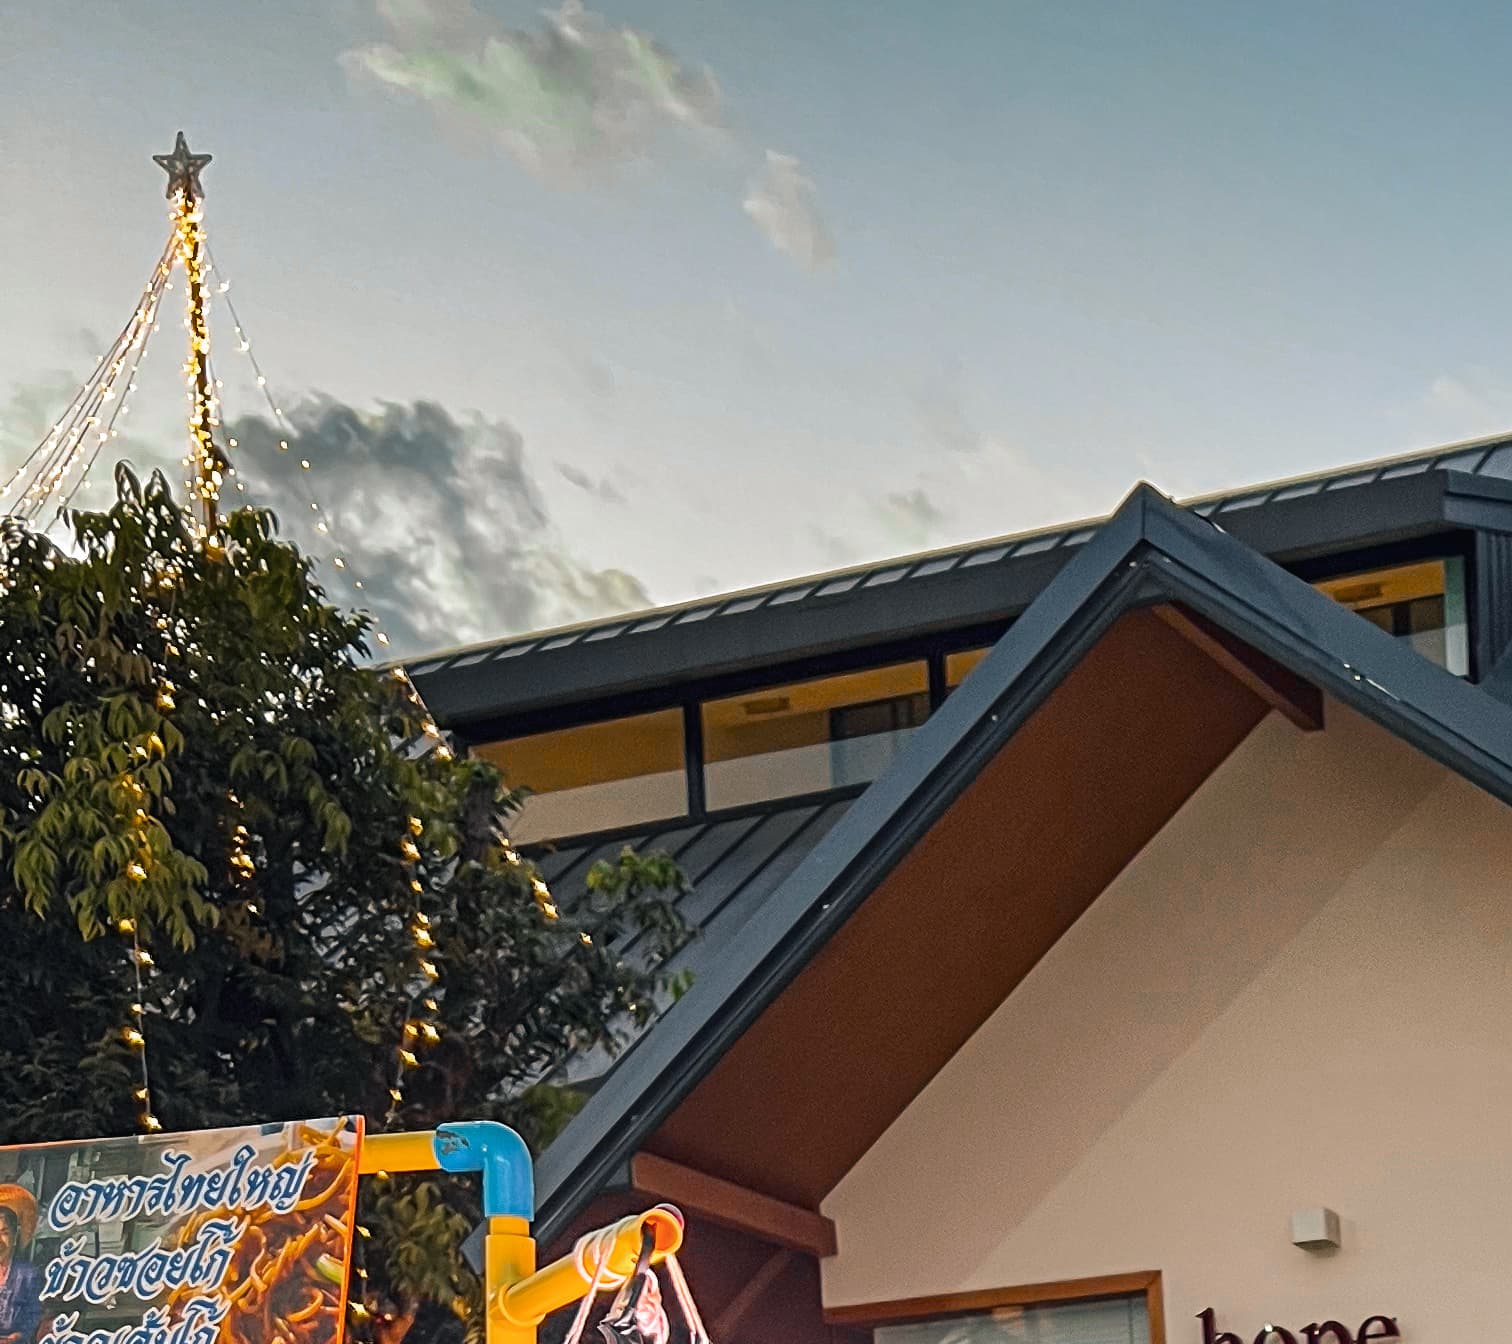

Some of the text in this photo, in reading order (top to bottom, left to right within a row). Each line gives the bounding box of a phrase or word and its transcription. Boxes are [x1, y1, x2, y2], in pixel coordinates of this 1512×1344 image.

[50, 1145, 314, 1230] อาหารไทยใหญ่
